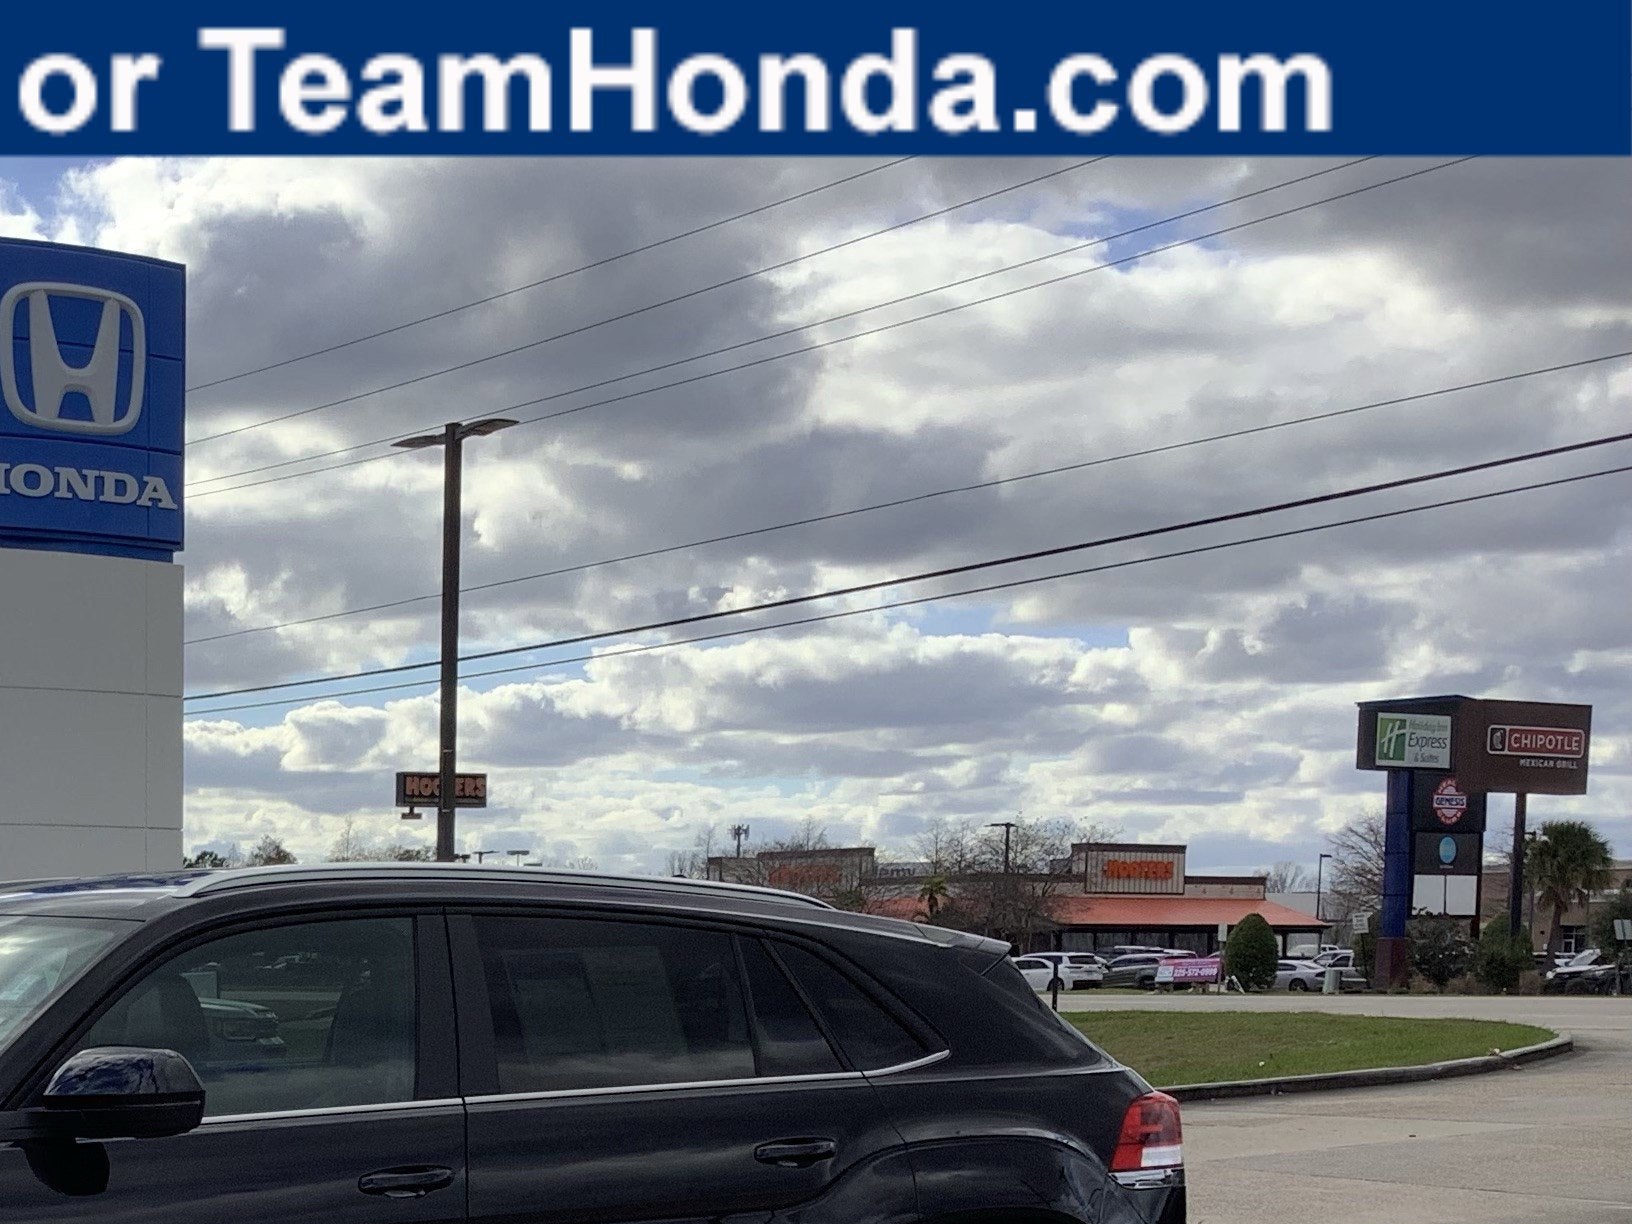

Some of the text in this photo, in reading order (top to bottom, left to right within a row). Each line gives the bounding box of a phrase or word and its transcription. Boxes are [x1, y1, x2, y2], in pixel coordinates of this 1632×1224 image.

[1408, 732, 1448, 751] Express
[1510, 733, 1580, 751] CHIPOTLE
[1519, 758, 1578, 769] MEXICAN GRILL
[1435, 797, 1465, 806] GENESIS
